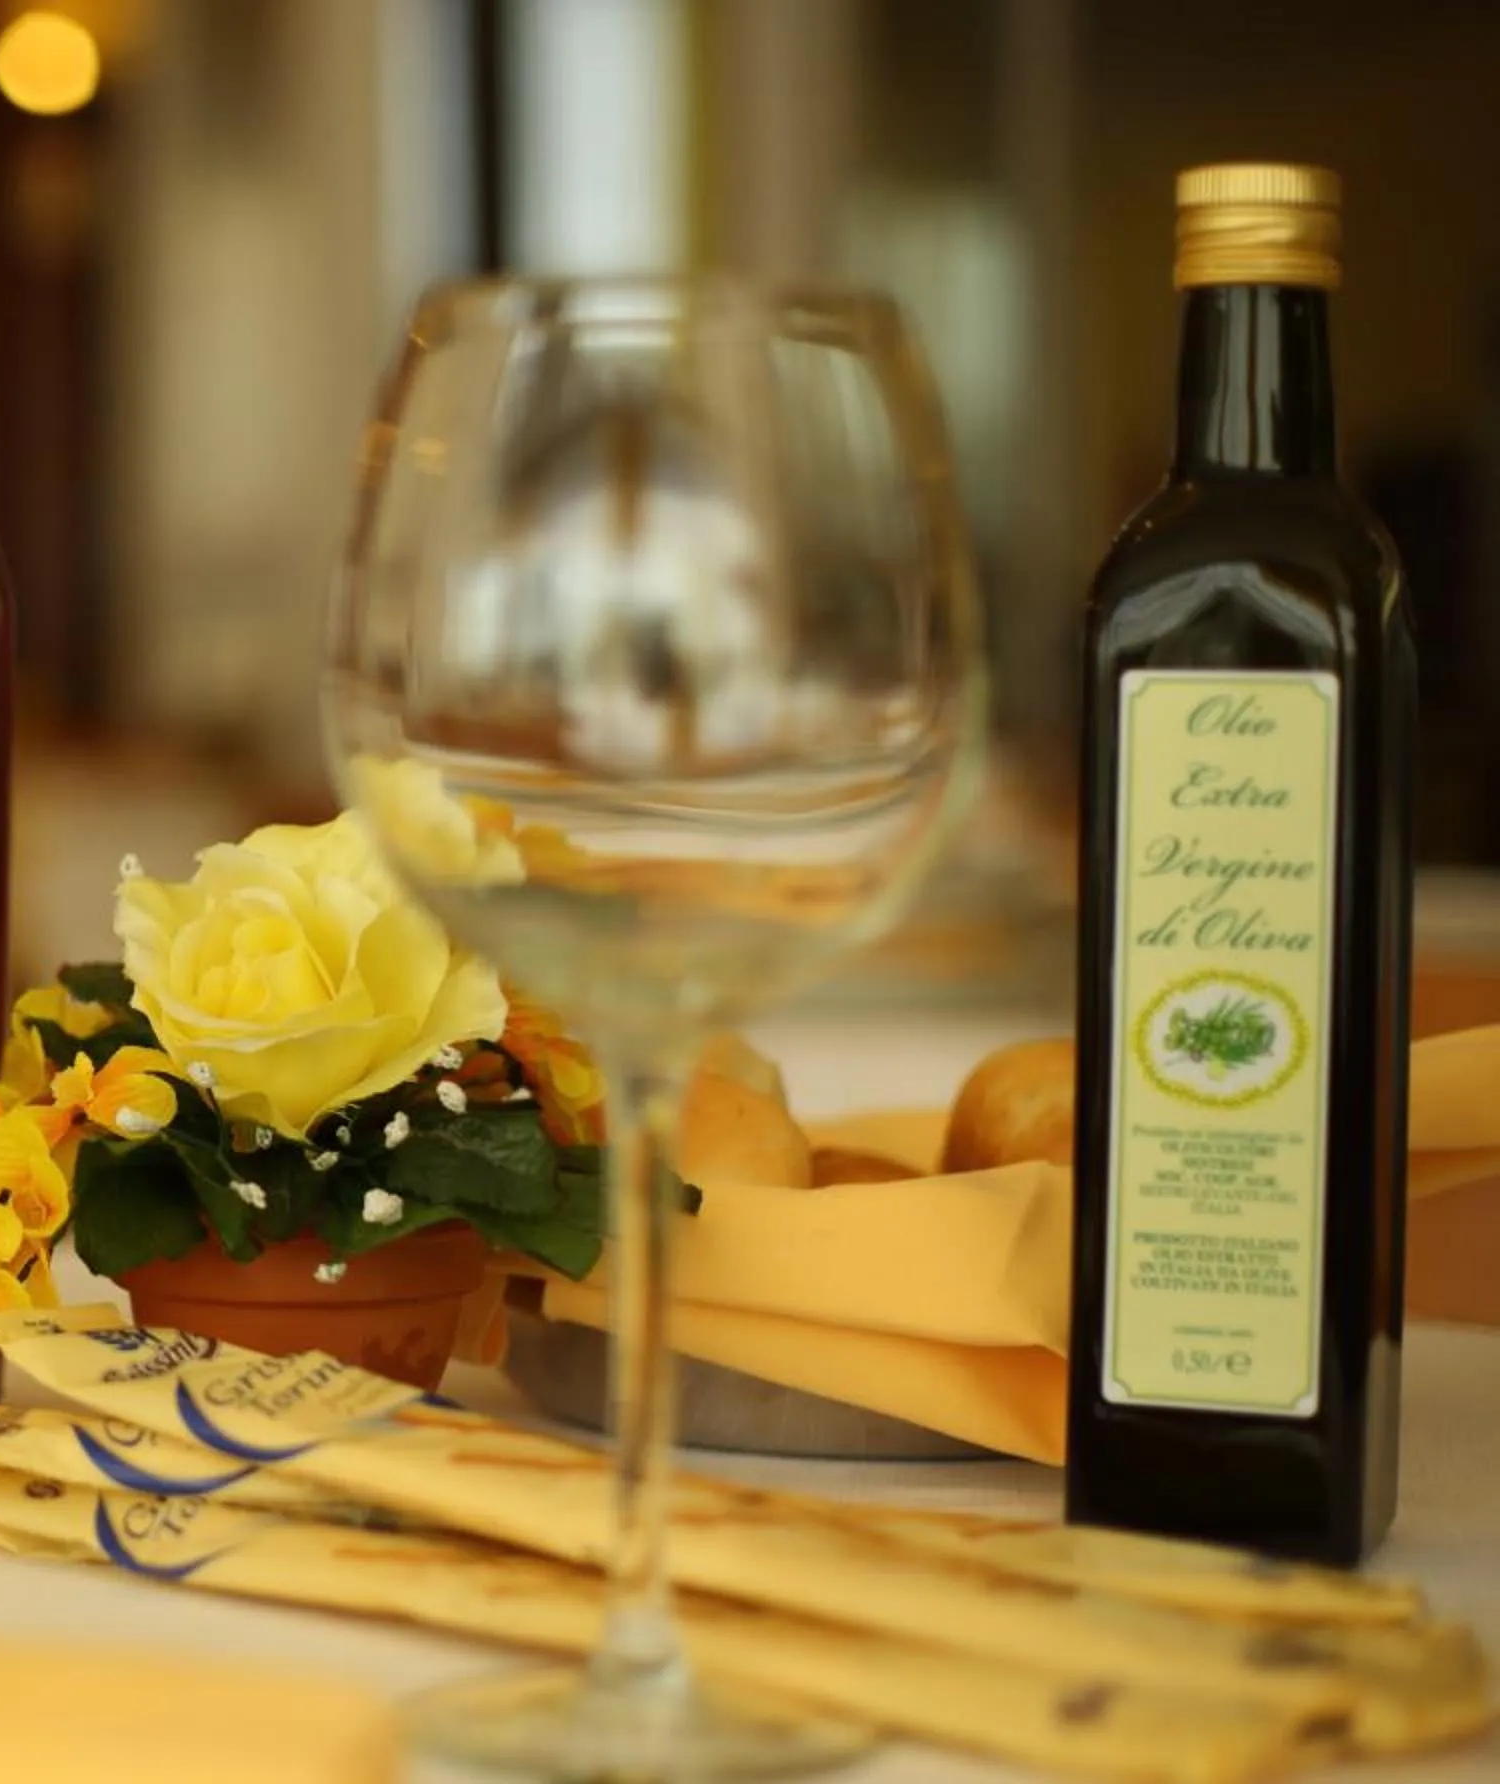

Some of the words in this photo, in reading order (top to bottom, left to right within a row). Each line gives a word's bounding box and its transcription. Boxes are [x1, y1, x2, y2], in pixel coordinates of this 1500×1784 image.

[1187, 693, 1276, 736] Olio
[1171, 761, 1289, 808] Extra
[1138, 834, 1314, 912] Vergine
[1137, 905, 1186, 947] di
[1194, 908, 1312, 950] Oliva
